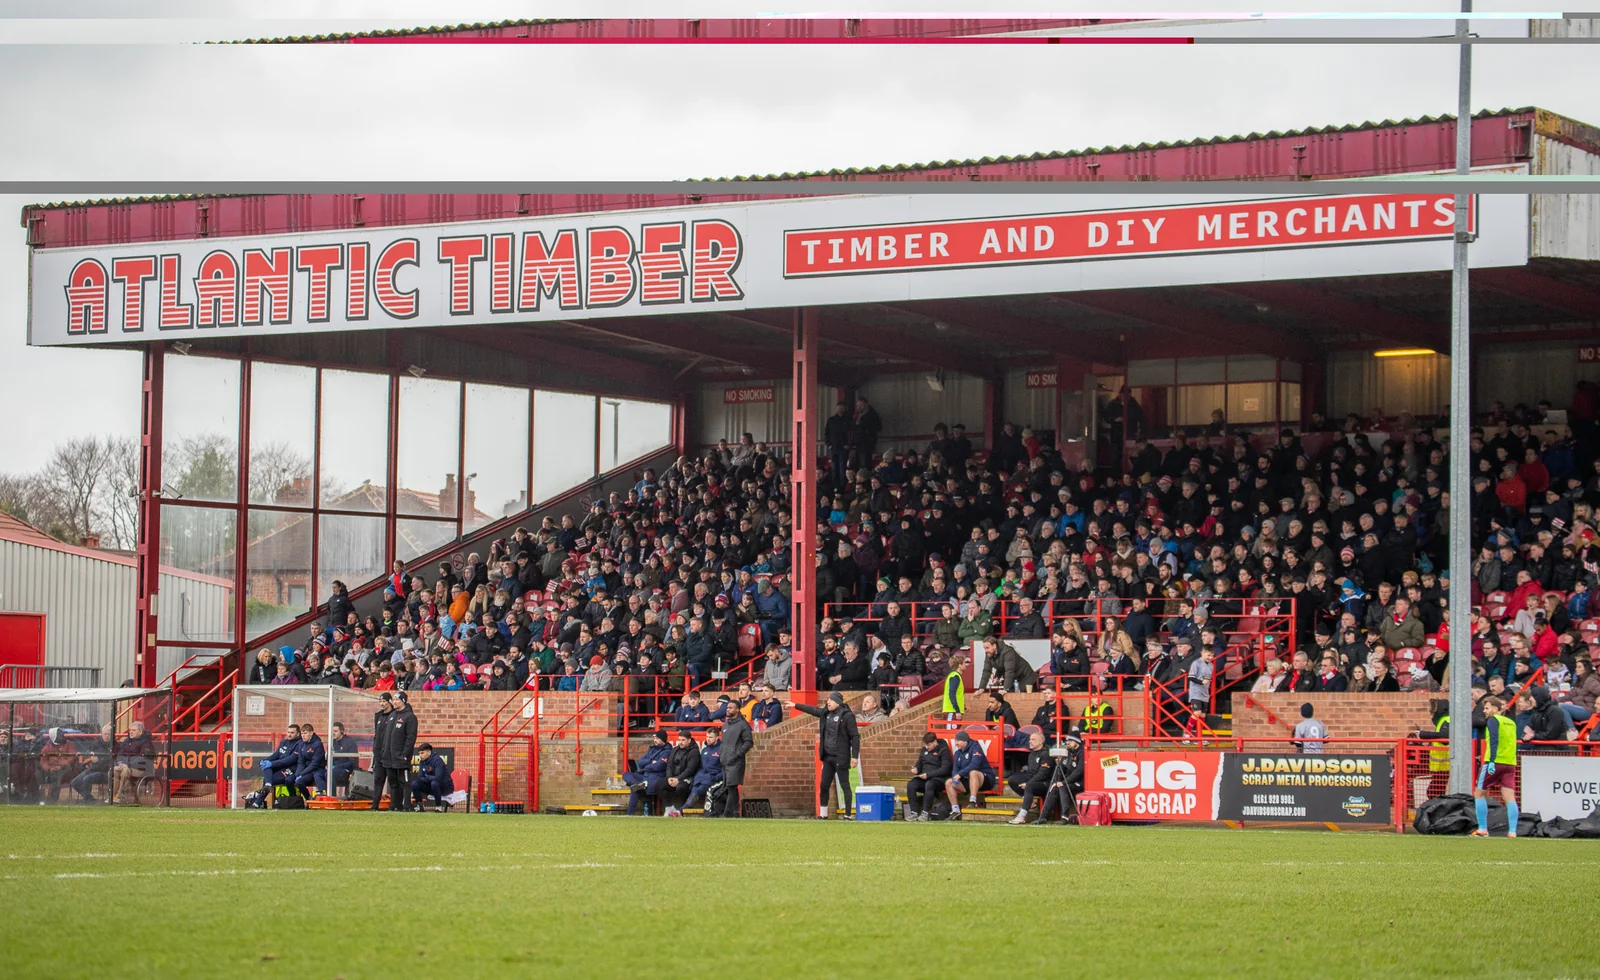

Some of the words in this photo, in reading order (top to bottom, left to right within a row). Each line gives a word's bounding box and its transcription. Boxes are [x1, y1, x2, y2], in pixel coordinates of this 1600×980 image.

[800, 232, 950, 266] TIMBER
[978, 224, 1056, 256] AND
[1087, 217, 1166, 248] DIY
[1197, 198, 1455, 241] MERCHANTS
[65, 237, 420, 335] ATLANTIC
[438, 218, 745, 316] TIMBER
[1027, 374, 1040, 386] NO
[725, 390, 737, 401] NO
[739, 388, 772, 400] SMOKING
[1242, 758, 1372, 773] J.DAVIDSON
[1103, 760, 1197, 790] BIG
[1242, 774, 1274, 786] SCRAP
[1277, 775, 1306, 786] METAL
[1309, 775, 1372, 787] PROCESSORS
[1553, 781, 1600, 795] POWE
[1135, 792, 1197, 815] SCRAP
